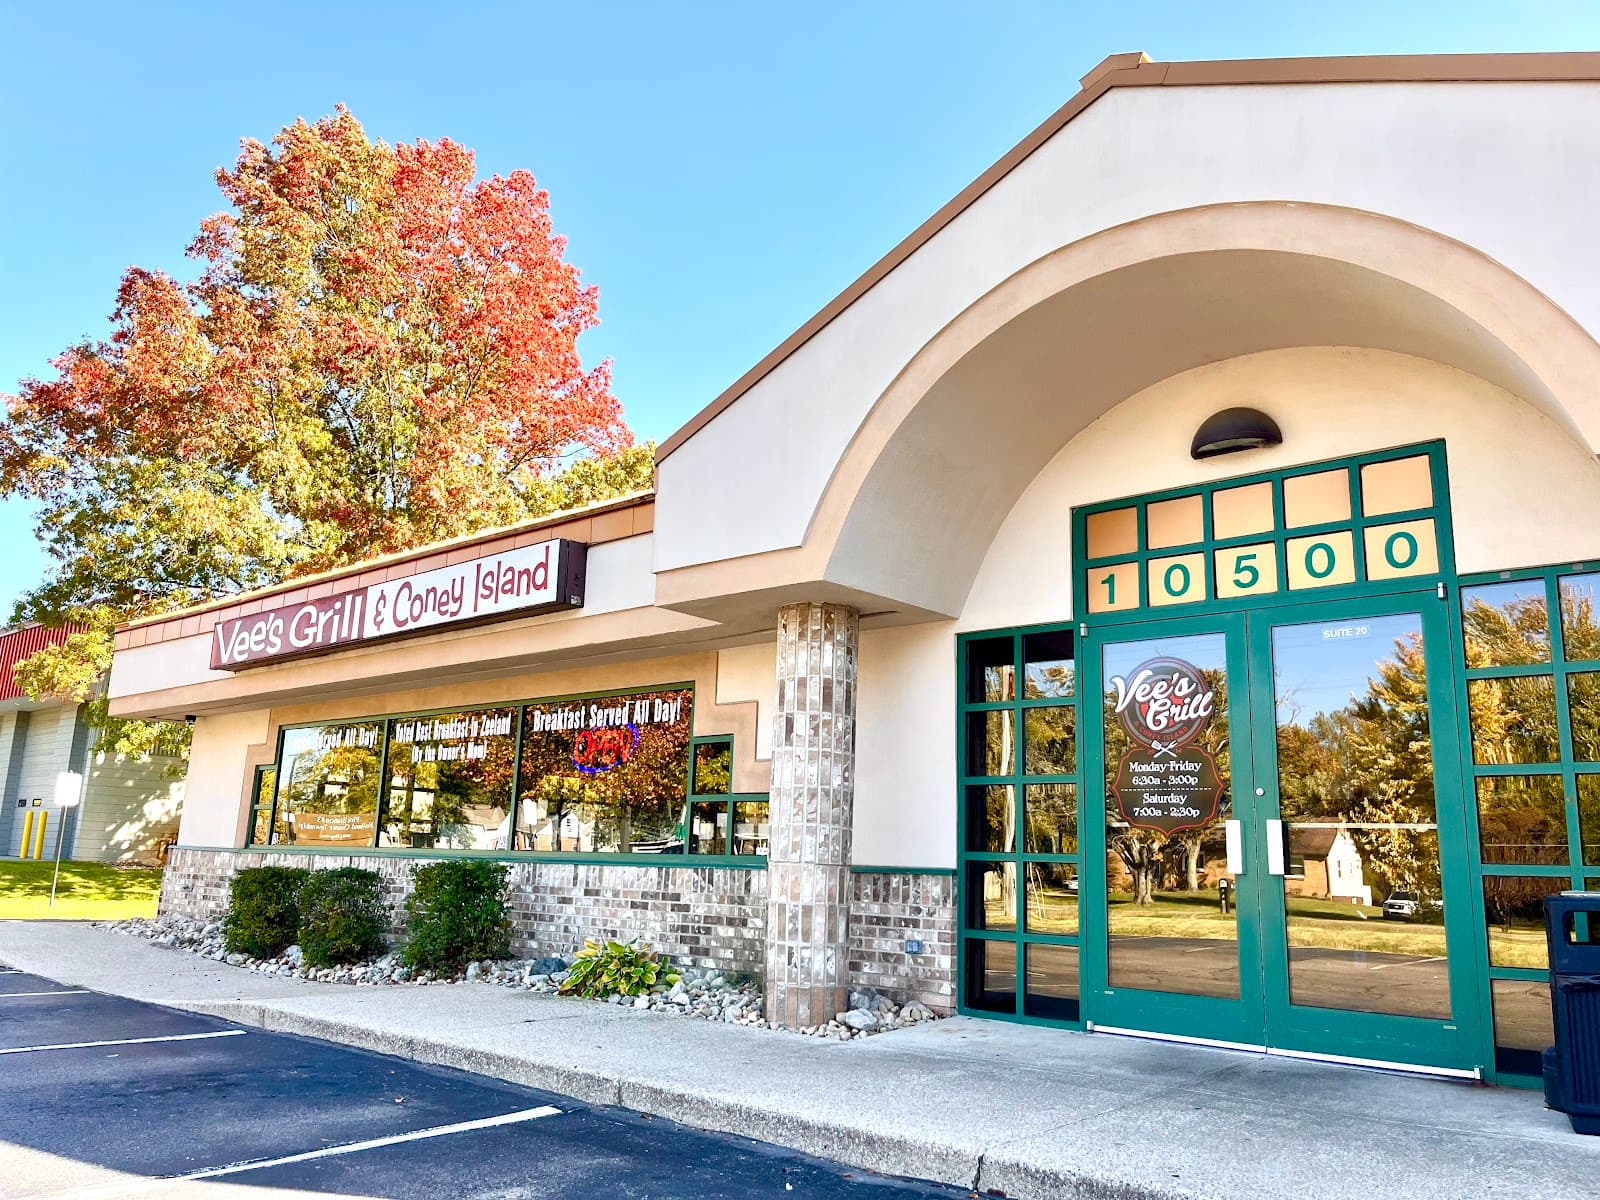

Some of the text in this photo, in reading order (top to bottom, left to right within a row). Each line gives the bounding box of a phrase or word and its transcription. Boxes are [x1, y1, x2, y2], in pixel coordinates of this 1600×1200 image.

[215, 545, 550, 664] Vee's Grill & Coney Island
[1323, 626, 1368, 639] SUITE 20
[1112, 669, 1197, 713] Vee's
[534, 696, 682, 732] Breakfast Served All Day!
[1145, 692, 1213, 731] Grill
[344, 727, 356, 747] All
[359, 725, 379, 749] Day!
[480, 712, 511, 737] Zeeland
[574, 729, 633, 763] OPEN
[1132, 775, 1160, 785] 6:30a
[1168, 775, 1198, 785] 3:00p
[1143, 792, 1187, 804] Saturday
[1133, 807, 1161, 817] 7:00a
[1170, 807, 1200, 817] 2:30p
